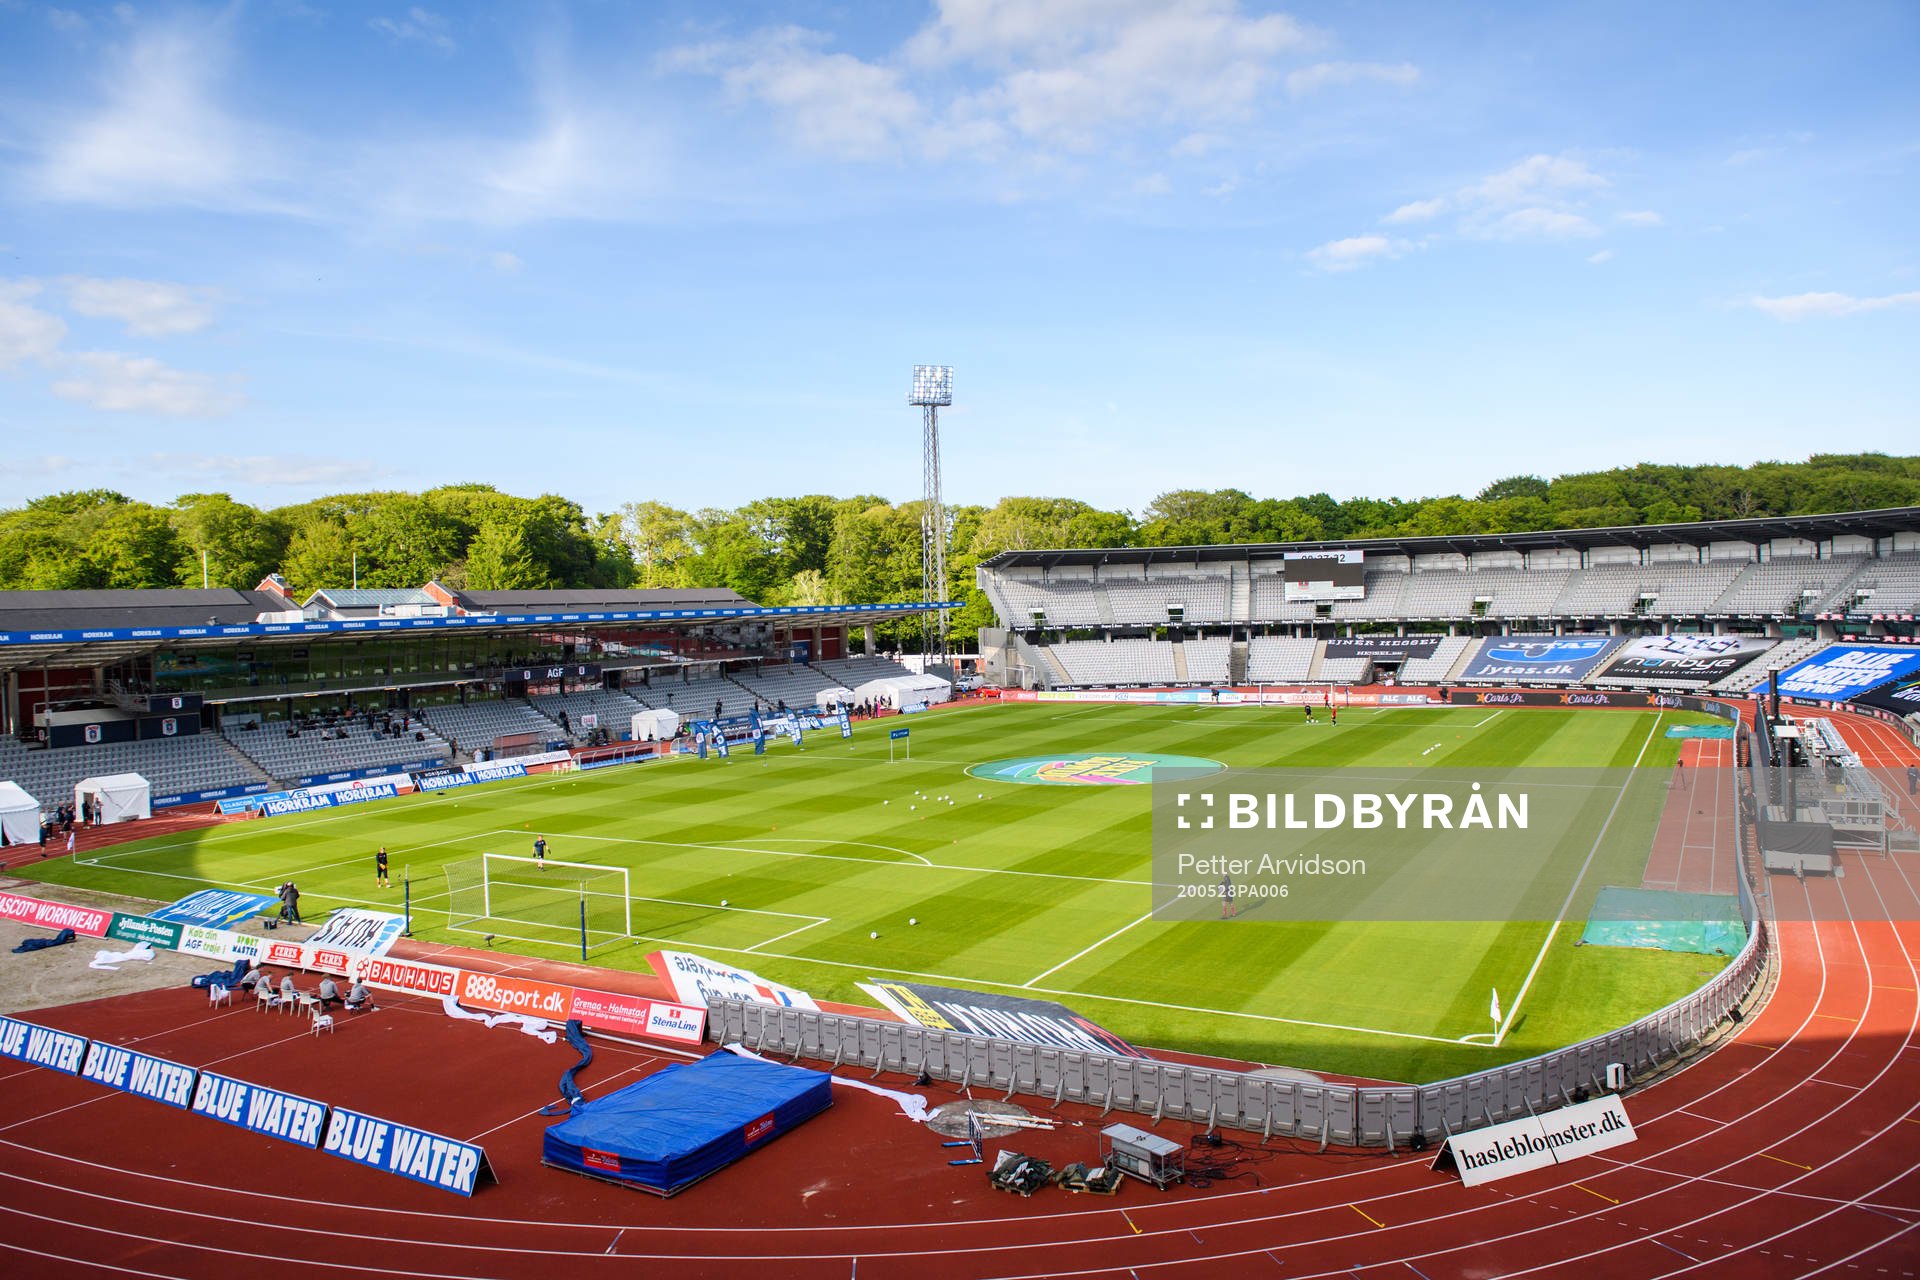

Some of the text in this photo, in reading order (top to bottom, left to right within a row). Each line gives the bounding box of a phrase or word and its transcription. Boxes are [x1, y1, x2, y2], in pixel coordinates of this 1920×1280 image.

[1476, 664, 1576, 674] jytas.dk
[1624, 657, 1737, 670] nonbye
[1823, 651, 1916, 670] BLUE
[546, 668, 564, 678] AGF
[1786, 664, 1892, 686] WATER
[1484, 692, 1509, 704] Carl's
[1568, 693, 1593, 704] Carl's
[422, 772, 472, 790] HØRKRAM
[476, 765, 524, 781] HØRKRAM
[335, 785, 394, 802] HØRKRAM
[267, 794, 331, 814] HØRKRAM
[36, 901, 103, 931] WORKWEAR
[119, 917, 174, 936] Jyllands-Posten
[188, 928, 218, 940] Køb din
[185, 940, 202, 949] AGF
[236, 936, 259, 945] SPORT
[232, 945, 258, 956] MASTER
[274, 946, 298, 958] CERES
[319, 952, 343, 967] CERES
[371, 964, 453, 991] BAUHAUS
[465, 975, 565, 1014] 888sport.dk
[574, 998, 602, 1009] Grenaa
[608, 1002, 647, 1018] Halmstad
[652, 1016, 697, 1032] Stena Line
[26, 1028, 83, 1073] WATER
[82, 1042, 192, 1106] BLUE WATER
[192, 1074, 323, 1145] BLUE WATER
[1460, 1110, 1626, 1170] hasleblomster.dk
[324, 1109, 478, 1193] BLUE WATER
